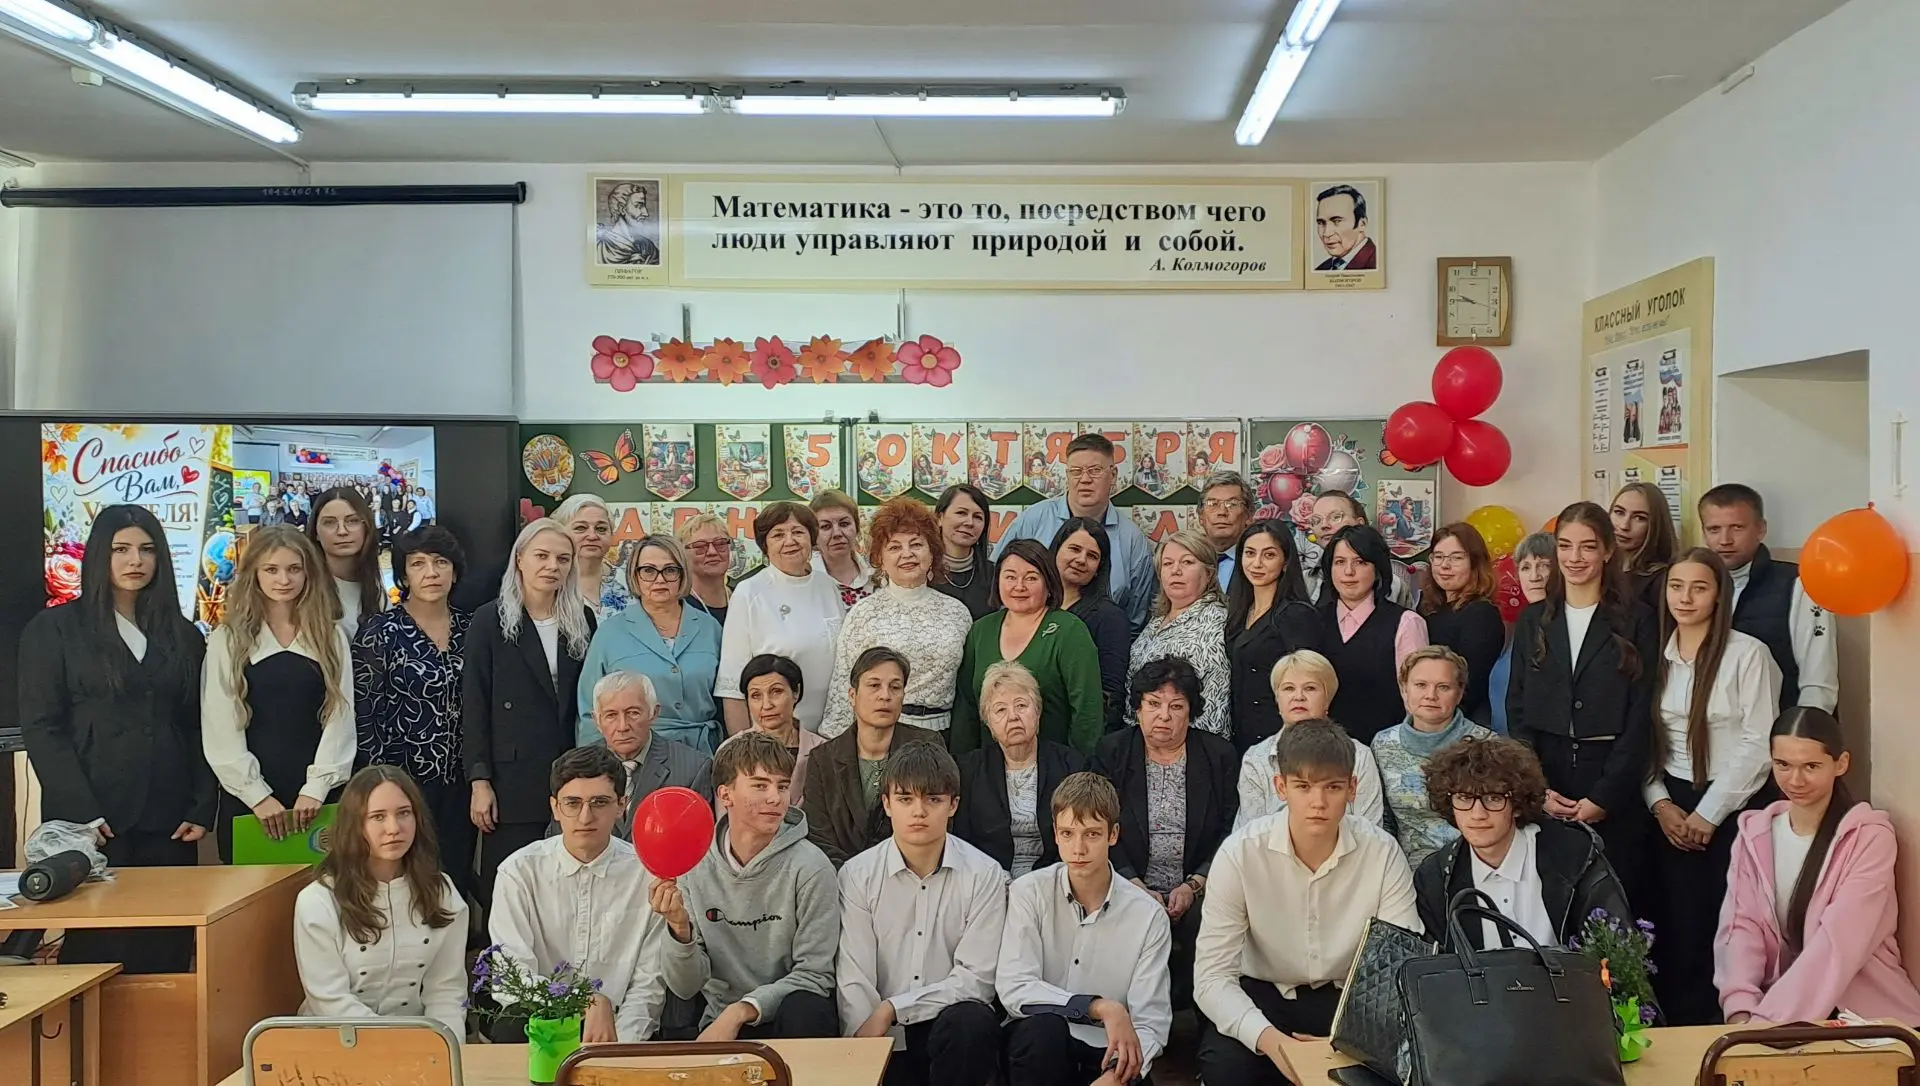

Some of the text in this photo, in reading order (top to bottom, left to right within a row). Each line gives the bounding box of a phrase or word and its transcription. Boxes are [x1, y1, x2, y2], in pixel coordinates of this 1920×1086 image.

[712, 195, 891, 219] Математика
[918, 202, 963, 220] это
[972, 202, 1010, 223] то,
[1020, 202, 1197, 226] посредством
[1207, 204, 1267, 222] чего
[712, 229, 1246, 256] люди управляют природой и собой.
[1149, 257, 1267, 275] А. Колмогоров
[1593, 300, 1641, 334] КЛАССНЫЙ
[1647, 287, 1686, 316] УГОЛОК
[73, 430, 185, 485] Спасибо
[806, 433, 833, 468] 5
[108, 470, 180, 502] Вам,
[82, 501, 199, 527] УЕЛЯ!
